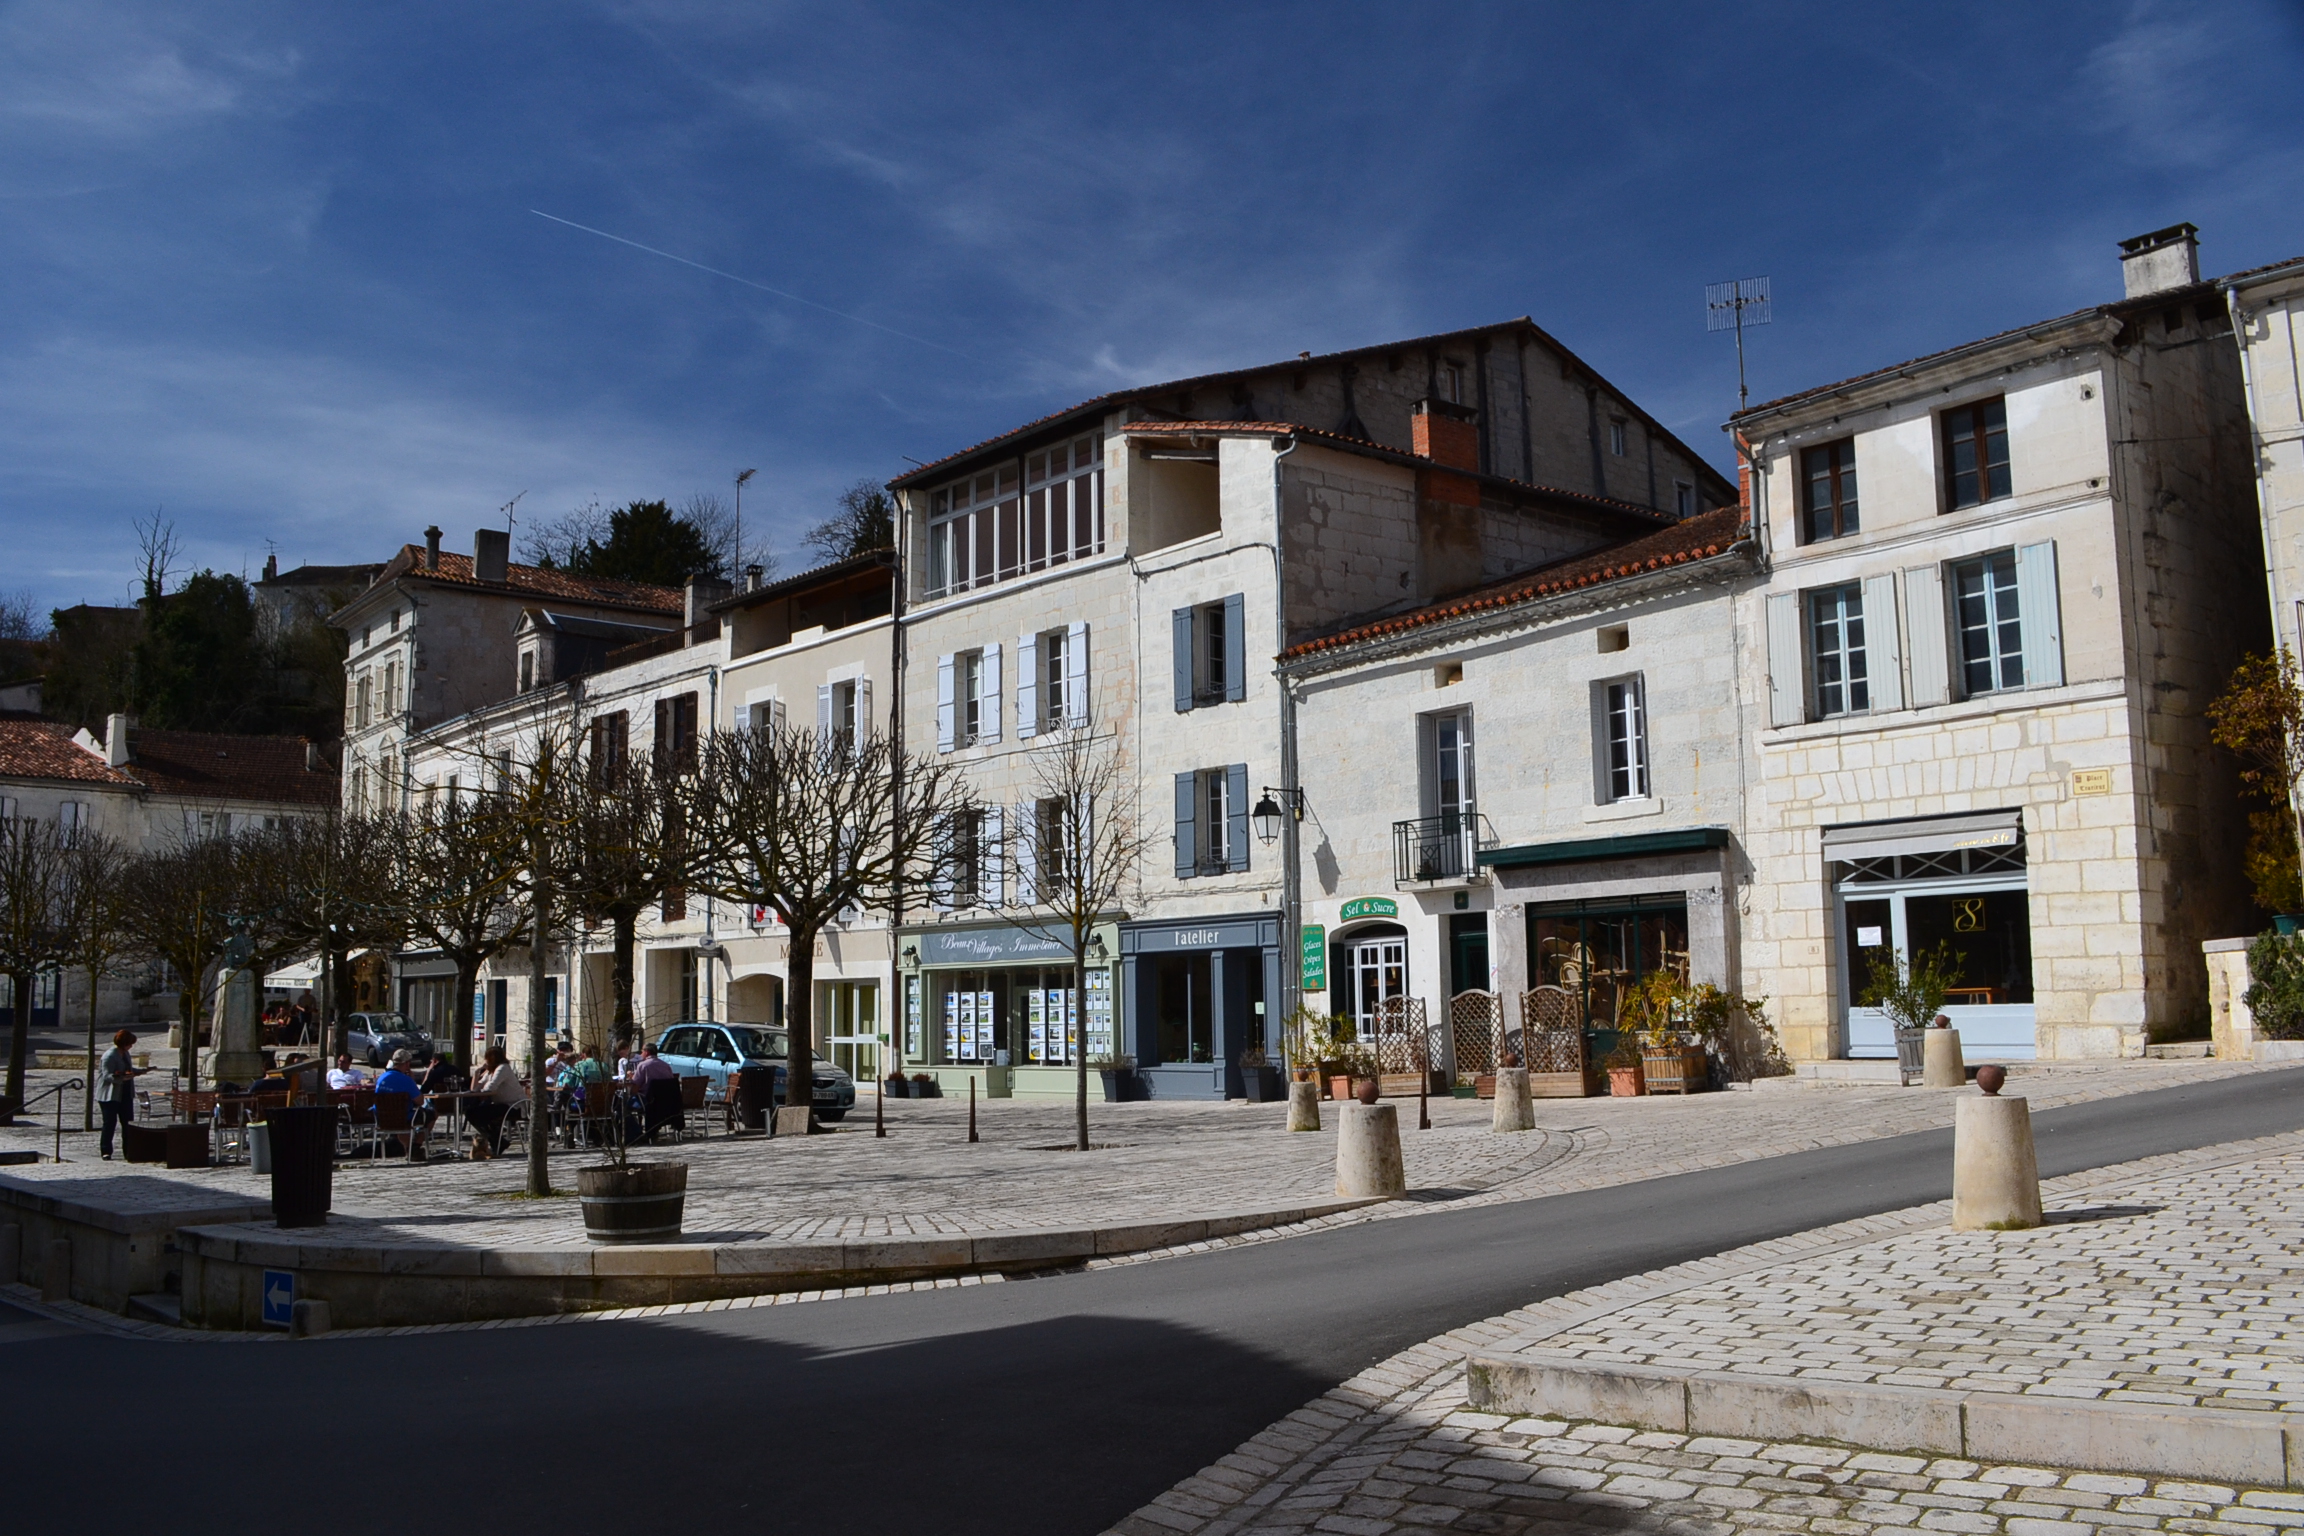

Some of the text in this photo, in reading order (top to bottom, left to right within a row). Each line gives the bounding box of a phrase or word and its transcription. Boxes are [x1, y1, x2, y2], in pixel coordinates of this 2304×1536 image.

[1345, 902, 1361, 917] Sel
[1371, 902, 1395, 914] Sucre
[967, 936, 1002, 960] Villages
[1303, 941, 1321, 953] Glaces
[1303, 955, 1321, 965] Crêpes
[1303, 966, 1324, 978] Salades
